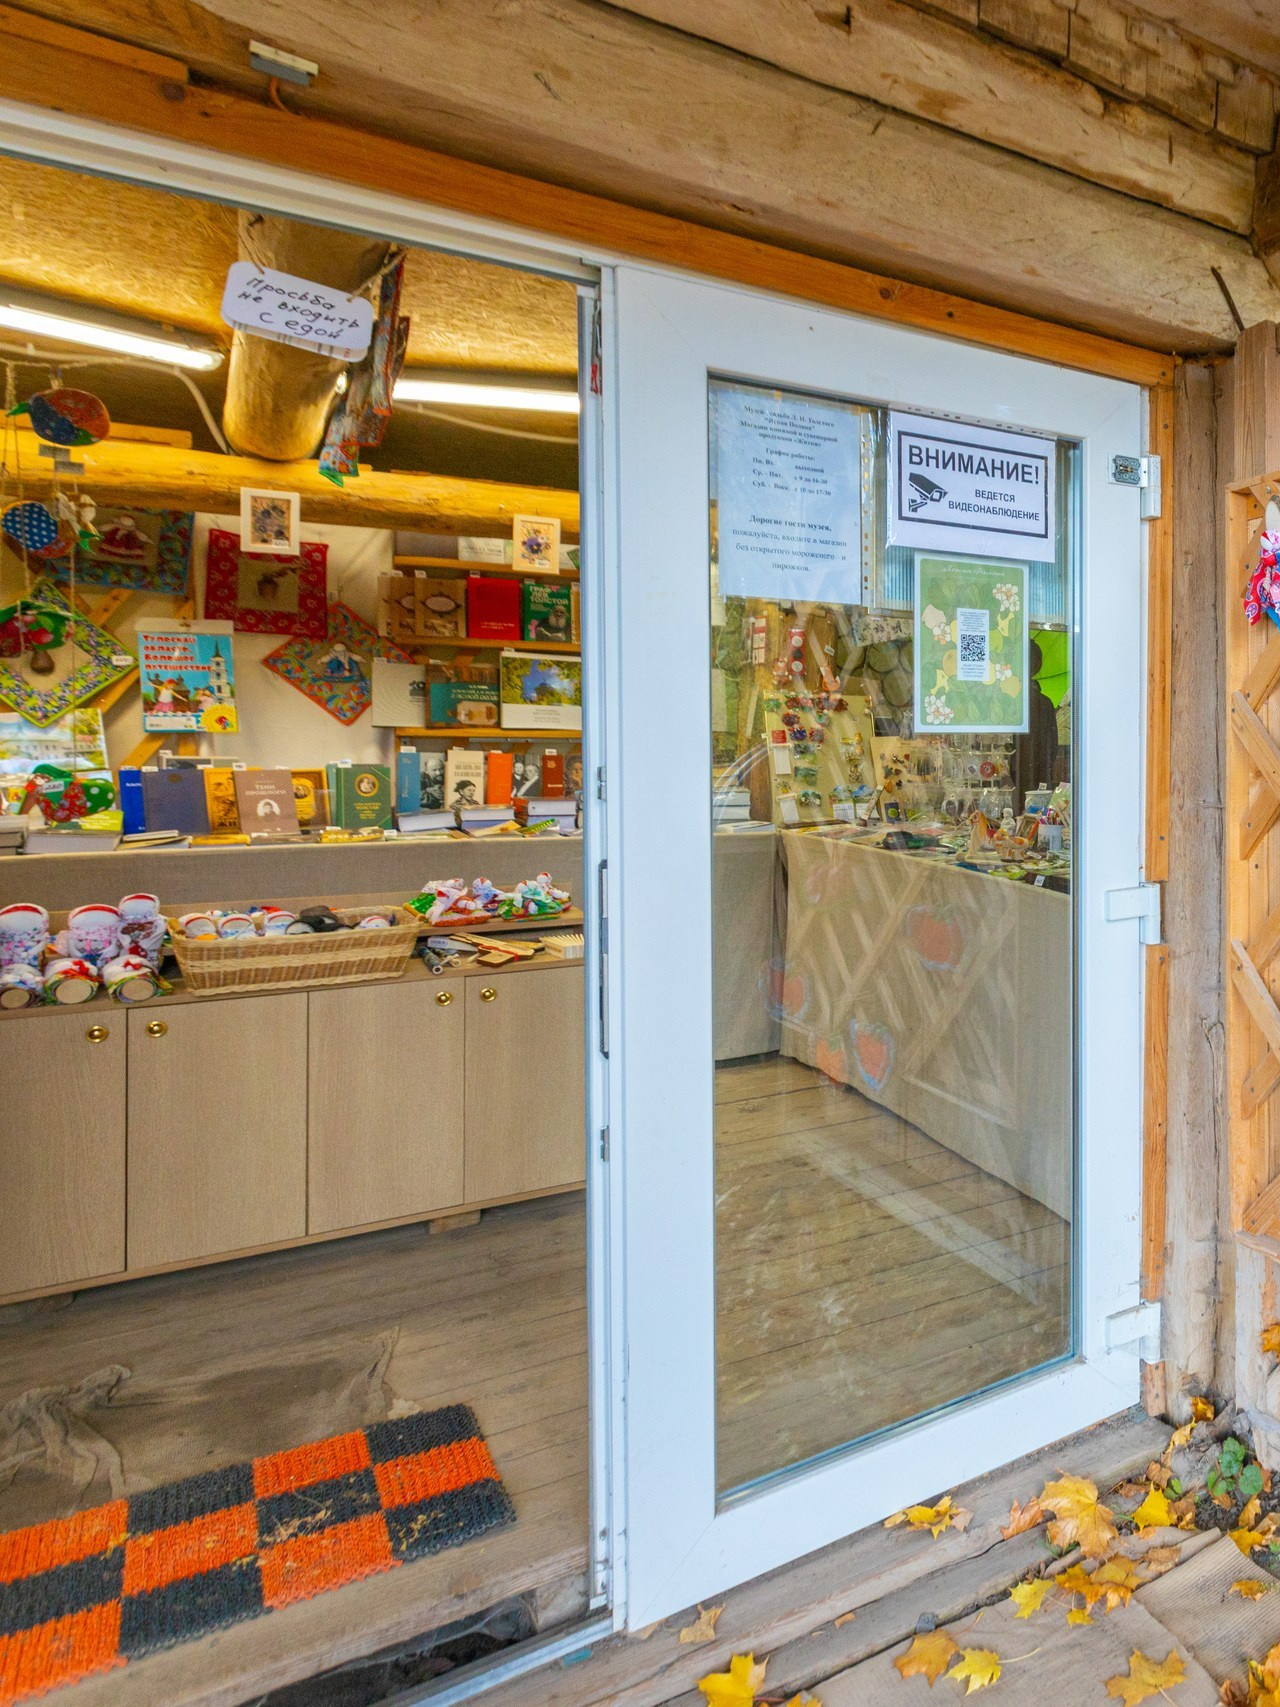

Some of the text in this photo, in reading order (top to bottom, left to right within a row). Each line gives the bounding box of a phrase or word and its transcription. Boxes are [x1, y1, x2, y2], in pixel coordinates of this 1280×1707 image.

[246, 277, 336, 311] Просьба
[237, 291, 360, 329] не входить
[284, 319, 344, 340] едой
[766, 447, 789, 457] График
[908, 444, 1040, 485] ВНИМАНИЕ!
[975, 489, 1015, 503] ВЕДЕТСЯ
[948, 500, 1040, 521] ВИДЕОНАБЛЮДЕНИЕ
[749, 515, 832, 532] Дорогие гости музея,
[732, 528, 780, 540] пожалуйста,
[818, 538, 847, 547] магазин
[735, 542, 749, 552] без
[750, 545, 790, 556] открытого
